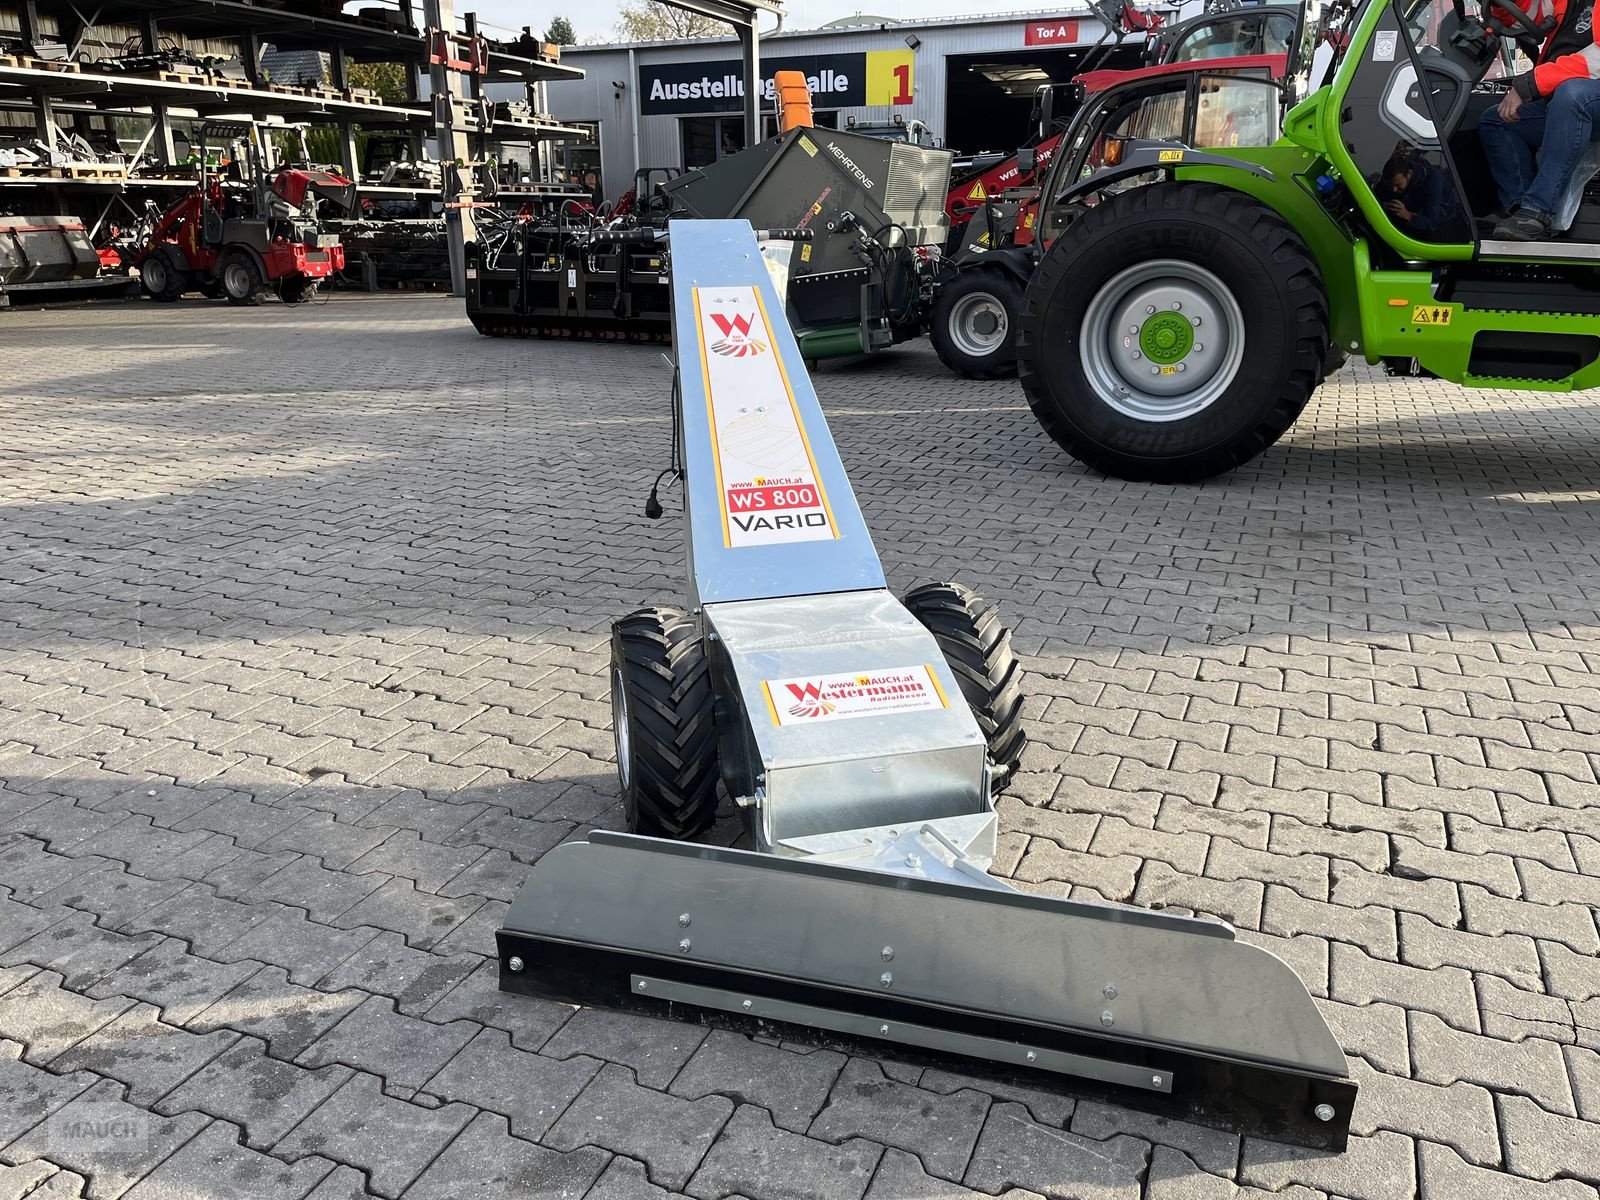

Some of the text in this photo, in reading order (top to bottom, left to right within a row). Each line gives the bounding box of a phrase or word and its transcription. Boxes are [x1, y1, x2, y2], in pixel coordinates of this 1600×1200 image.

[1036, 25, 1066, 38] Tor A
[893, 64, 913, 105] 1
[827, 142, 875, 189] MEHRTENS
[731, 488, 813, 509] WS 800
[731, 513, 827, 532] VARIO
[785, 680, 924, 703] Westermann
[870, 692, 927, 703] Radialbesen
